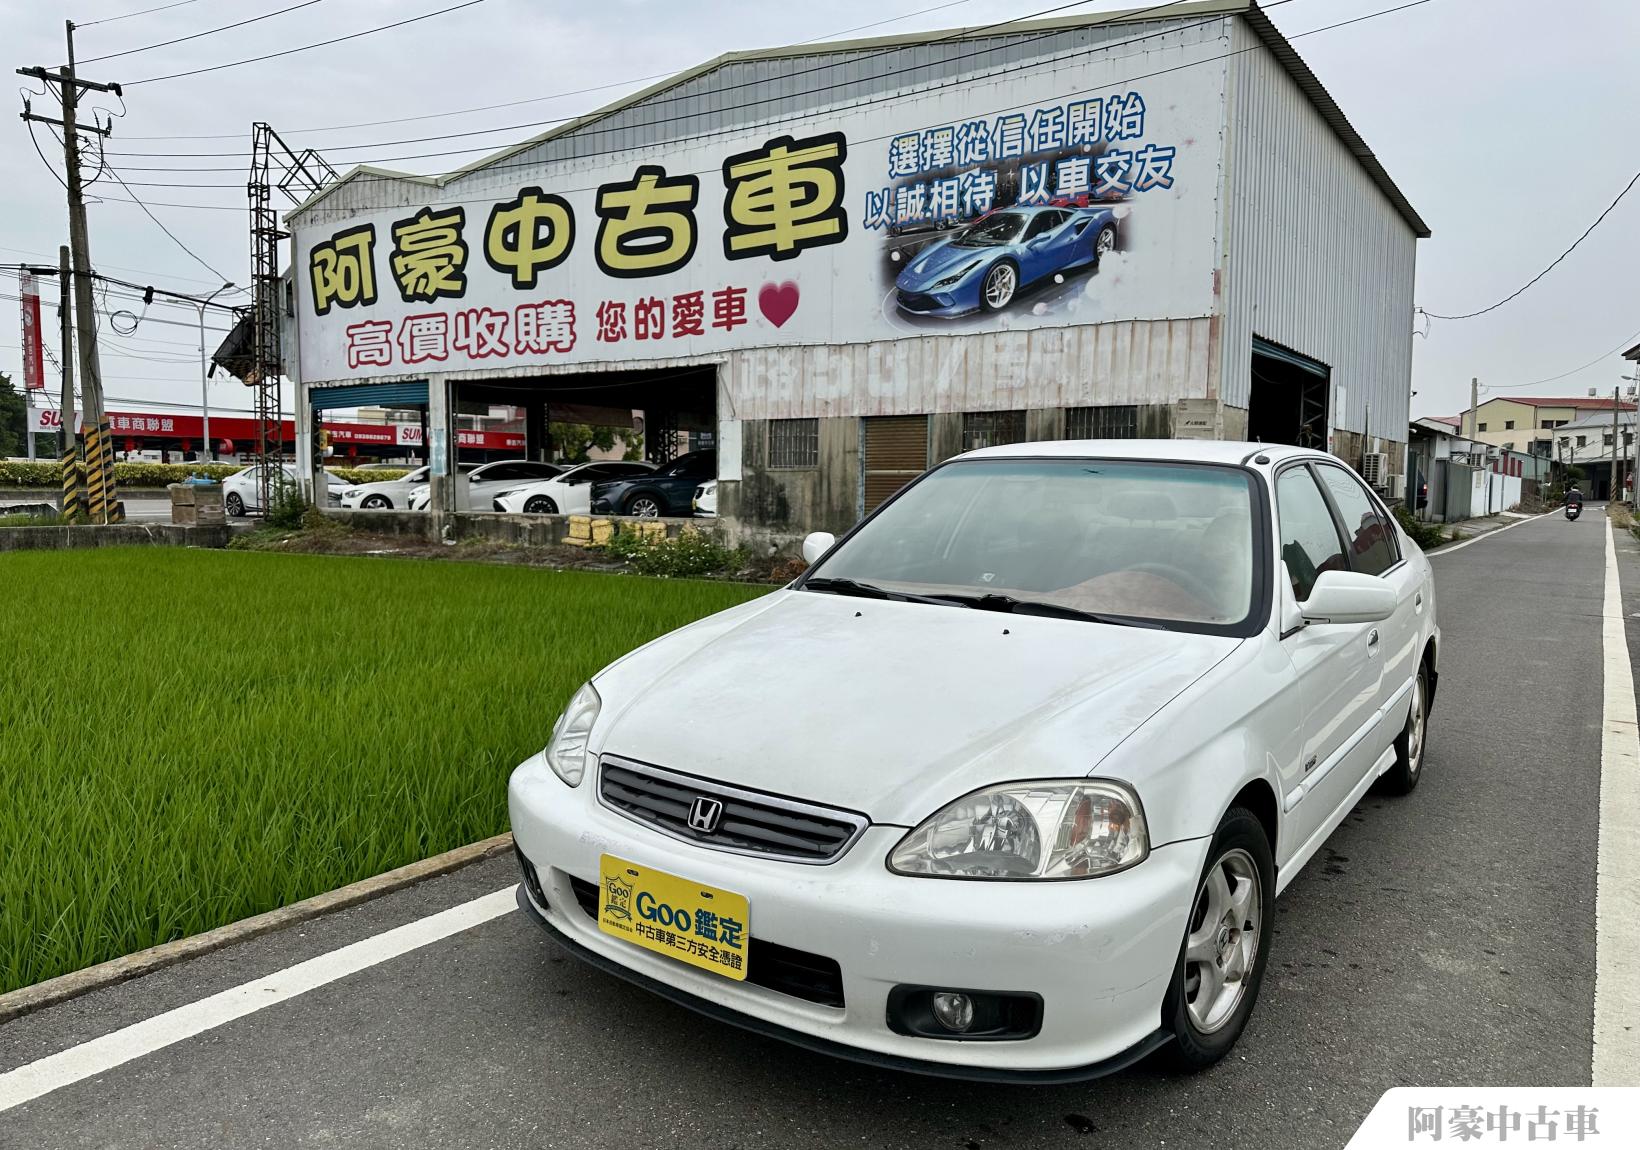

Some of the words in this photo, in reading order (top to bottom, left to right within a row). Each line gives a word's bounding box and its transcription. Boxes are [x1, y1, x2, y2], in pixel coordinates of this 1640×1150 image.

[888, 92, 1145, 179] 選擇從信任開始
[309, 131, 848, 315] 阿豪中古車
[863, 171, 996, 230] 以誠相待
[1018, 144, 1176, 206] 以車交友
[347, 299, 577, 369] 高價收購
[595, 285, 749, 342] 您的愛車
[608, 882, 629, 899] Goo
[636, 891, 692, 932] Goo
[694, 908, 743, 950] 鑑定
[635, 922, 743, 971] 中古車第三方安全憑證
